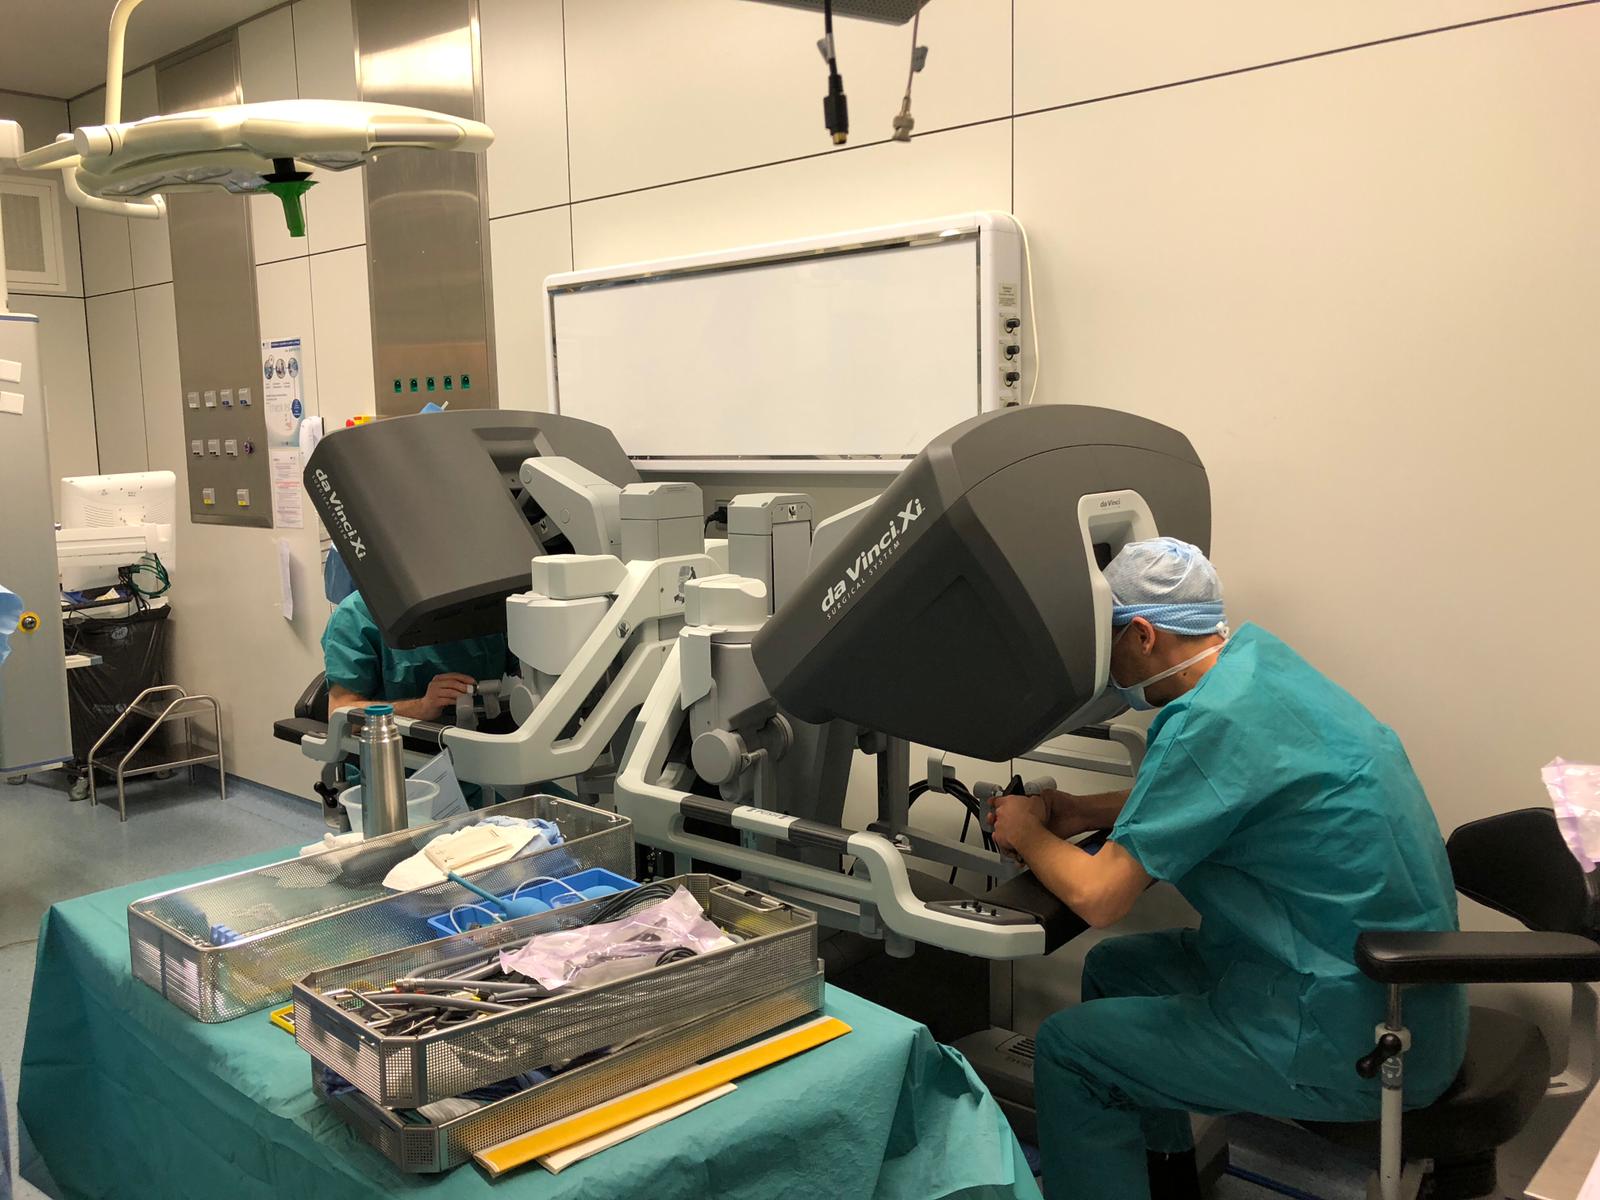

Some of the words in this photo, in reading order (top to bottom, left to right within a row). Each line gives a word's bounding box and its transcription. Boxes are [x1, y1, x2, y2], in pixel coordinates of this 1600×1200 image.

[316, 469, 331, 492] da
[329, 491, 357, 539] Vinci
[350, 536, 366, 559] Xi
[821, 580, 846, 612] da
[845, 520, 897, 581] Vinci
[897, 498, 923, 534] Xi
[827, 578, 866, 620] SURGICAL
[869, 540, 900, 576] SYSTEM
